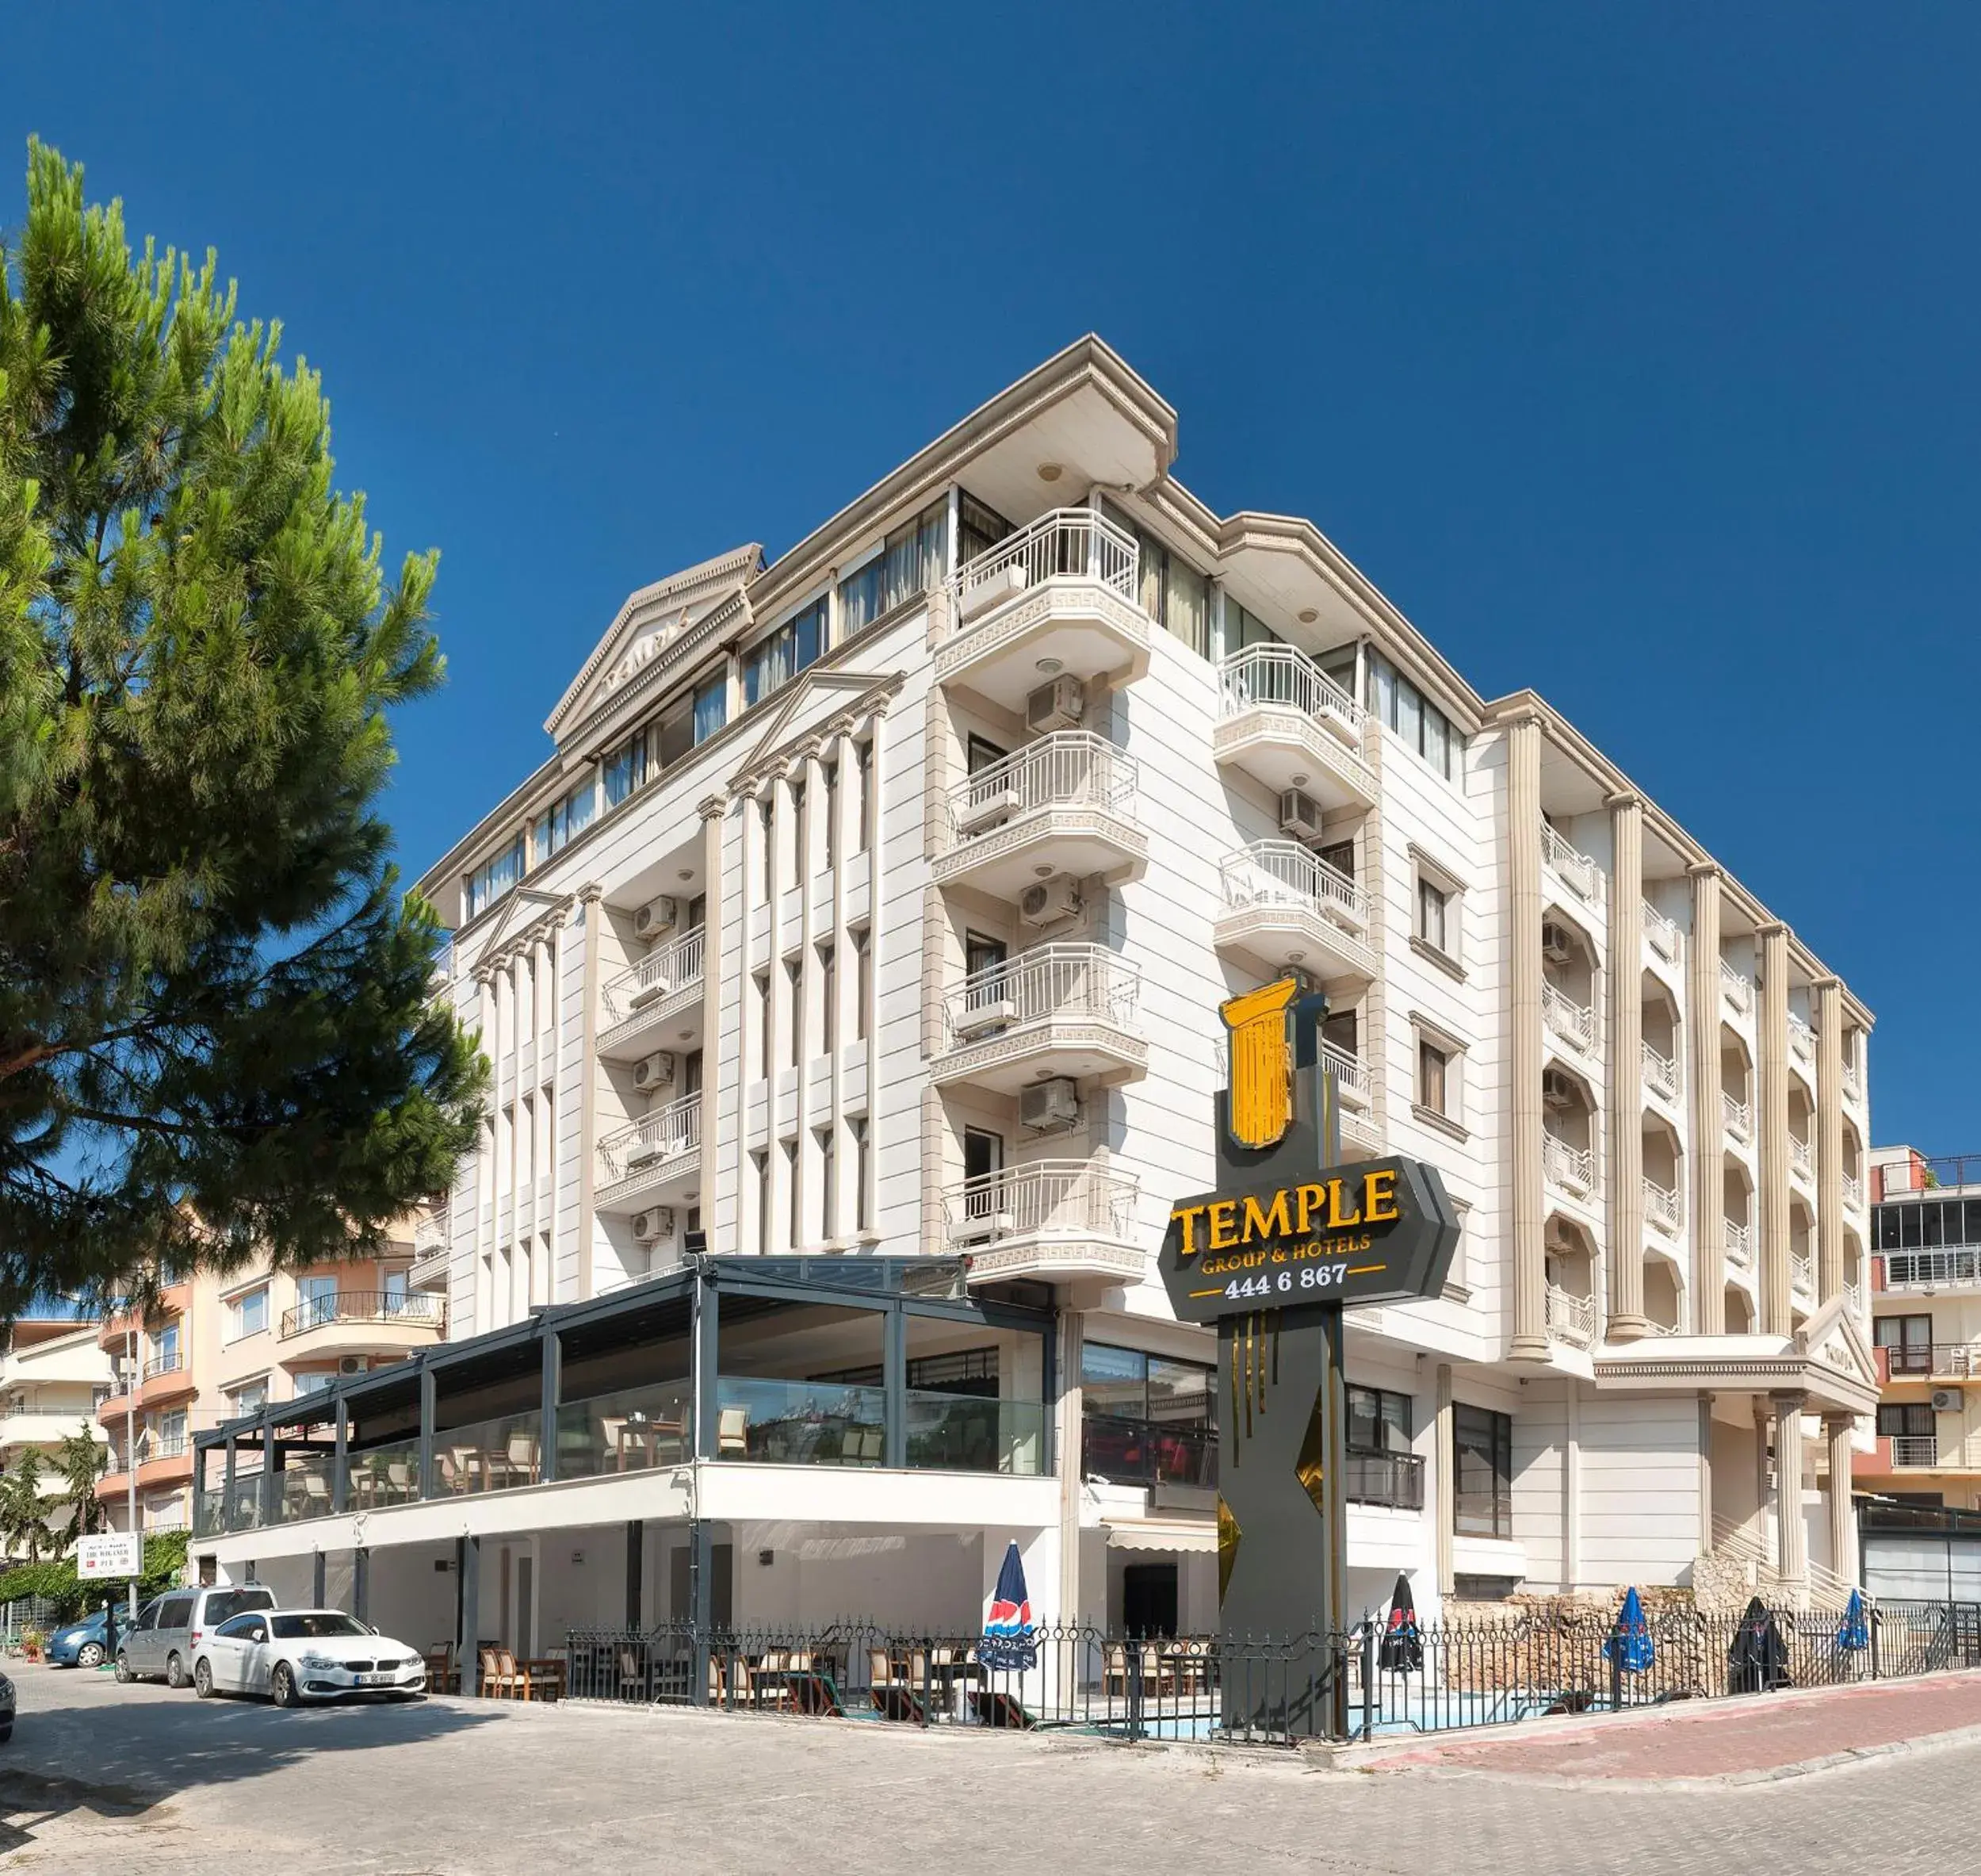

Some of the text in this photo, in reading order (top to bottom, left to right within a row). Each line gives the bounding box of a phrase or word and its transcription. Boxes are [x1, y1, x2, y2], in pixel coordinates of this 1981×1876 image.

[1170, 1169, 1399, 1254] TEMPLE
[1201, 1234, 1372, 1275] GROUP & HOTELS
[1225, 1262, 1348, 1300] 444 6 867
